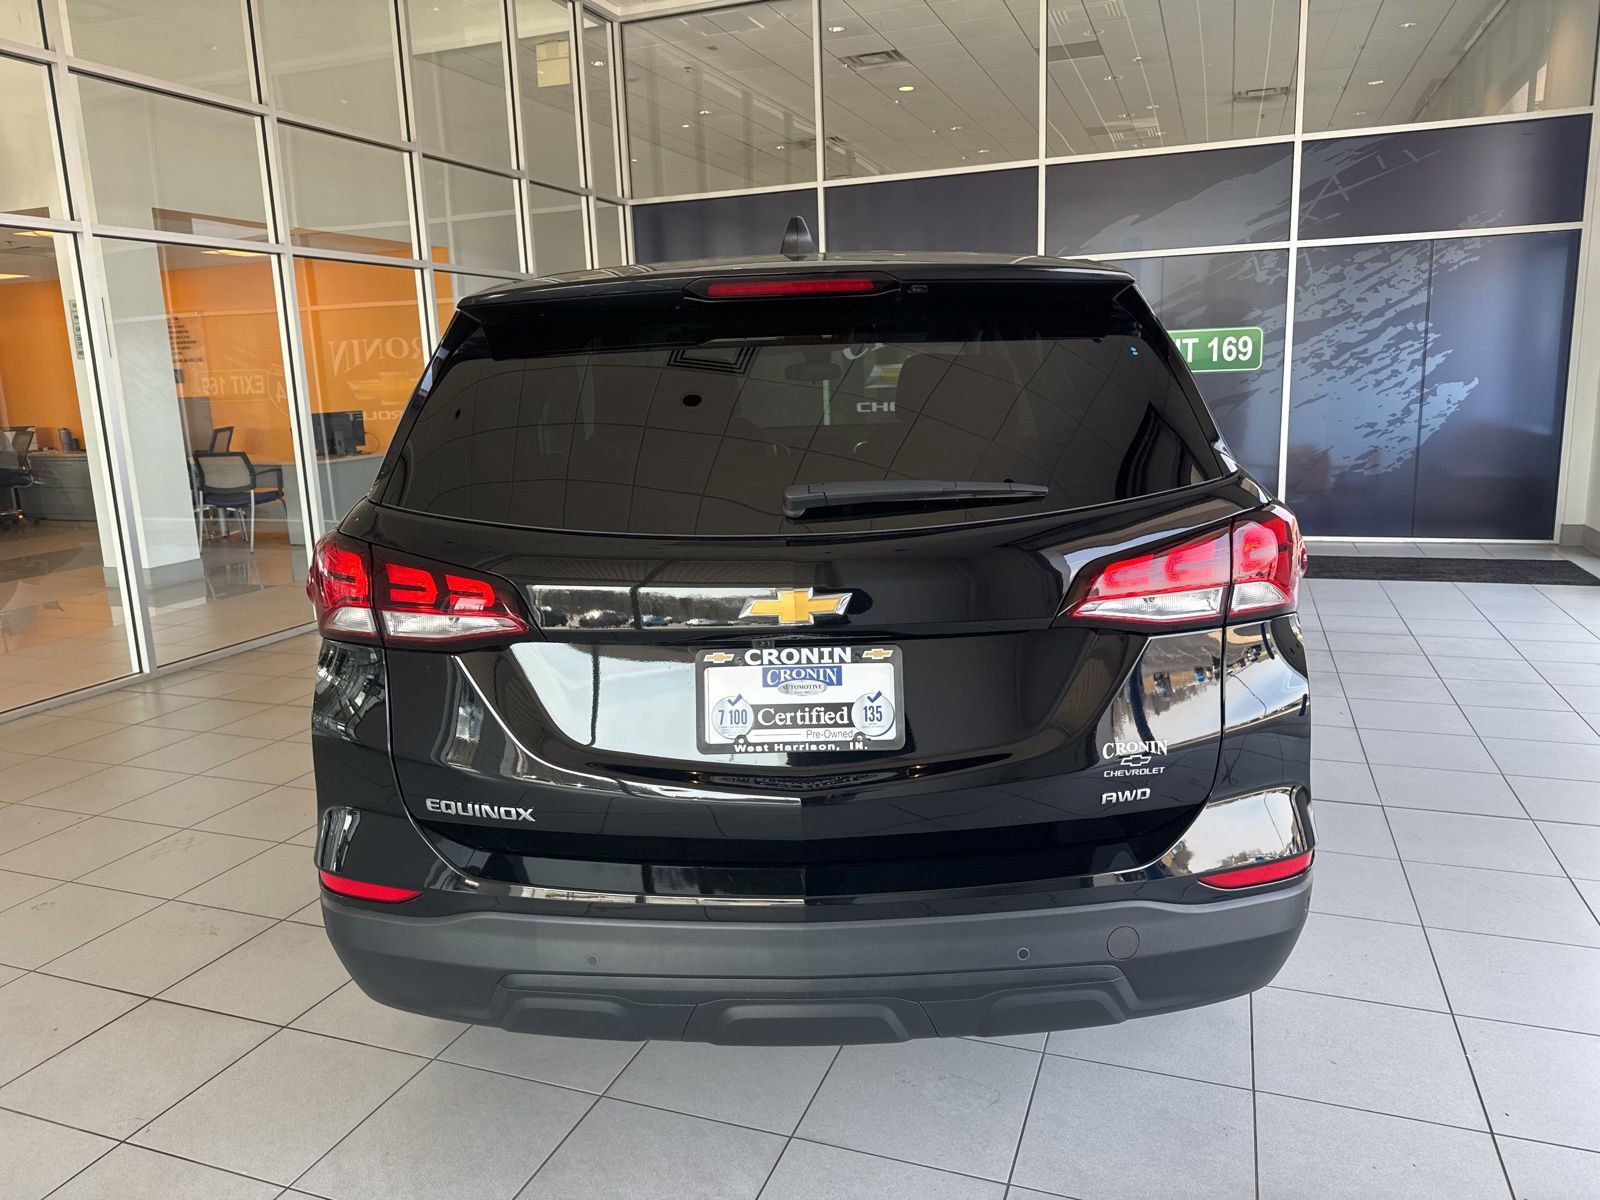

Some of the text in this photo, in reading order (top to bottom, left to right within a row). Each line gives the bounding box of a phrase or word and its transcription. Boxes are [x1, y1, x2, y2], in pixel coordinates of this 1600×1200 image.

[1207, 335, 1253, 362] 169
[744, 647, 852, 666] CRONIN
[766, 668, 838, 686] CRONIN
[729, 709, 748, 725] 100
[757, 705, 850, 726] Certified
[863, 705, 883, 722] 135
[806, 729, 854, 740] Pre-Owned
[733, 742, 769, 753] West
[849, 741, 868, 751] IN.
[1102, 740, 1168, 760] CRONIN
[1103, 767, 1166, 778] CHEVROLET
[1101, 787, 1151, 805] AWD
[425, 798, 536, 822] EQUINOX
